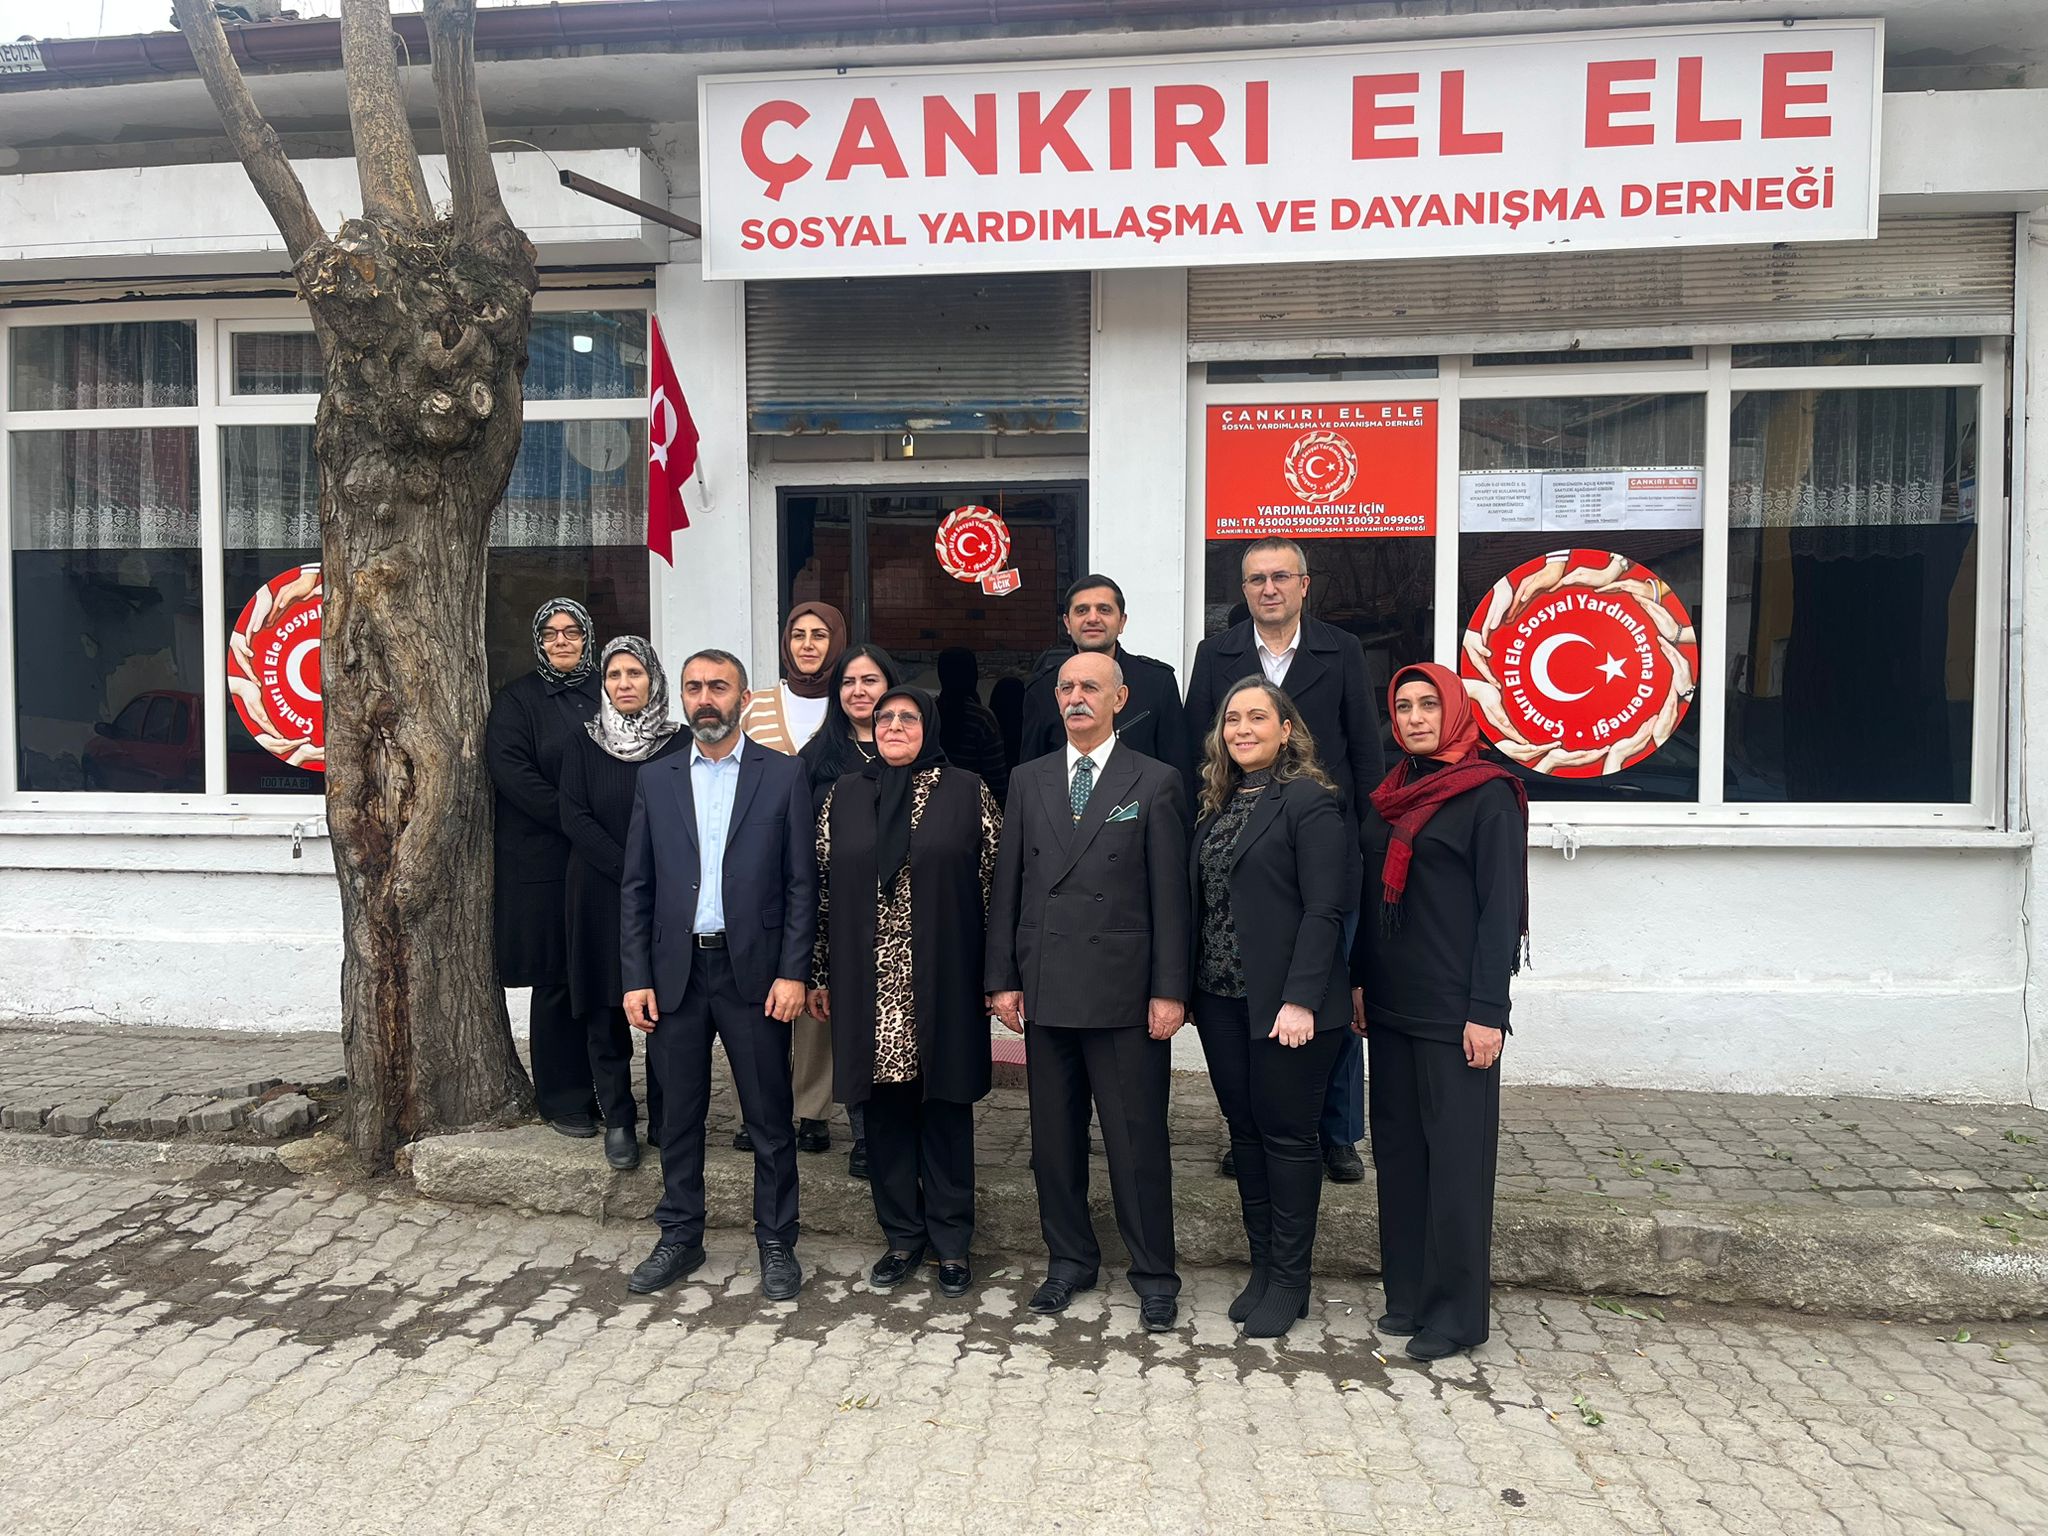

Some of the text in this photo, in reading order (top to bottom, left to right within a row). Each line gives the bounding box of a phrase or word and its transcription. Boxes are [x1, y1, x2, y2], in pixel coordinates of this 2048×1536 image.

[17, 63, 32, 73] 75
[741, 50, 1834, 202] ÇANKIRI EL ELE
[740, 166, 1834, 251] SOSYAL YARDIMLAŞMA VE DAYANIŞMA DERNEĞİ
[1222, 406, 1423, 423] ÇANKIRI EL ELE
[1222, 423, 1254, 431] SOSYAL
[1257, 422, 1318, 430] YARDIMLAŞMA
[1333, 420, 1383, 428] DAYANIŞMA
[1385, 418, 1423, 427] DERNEĞİ
[1257, 502, 1385, 516] YARDIMLARINIZ İÇİN
[1217, 515, 1425, 527] IBN: TR 450005900920130092 099605
[264, 604, 322, 735] Çankırı El Ele Sosyal
[1503, 593, 1654, 740] Çankırı El Ele Sosyal Yardımlaşma Derneği
